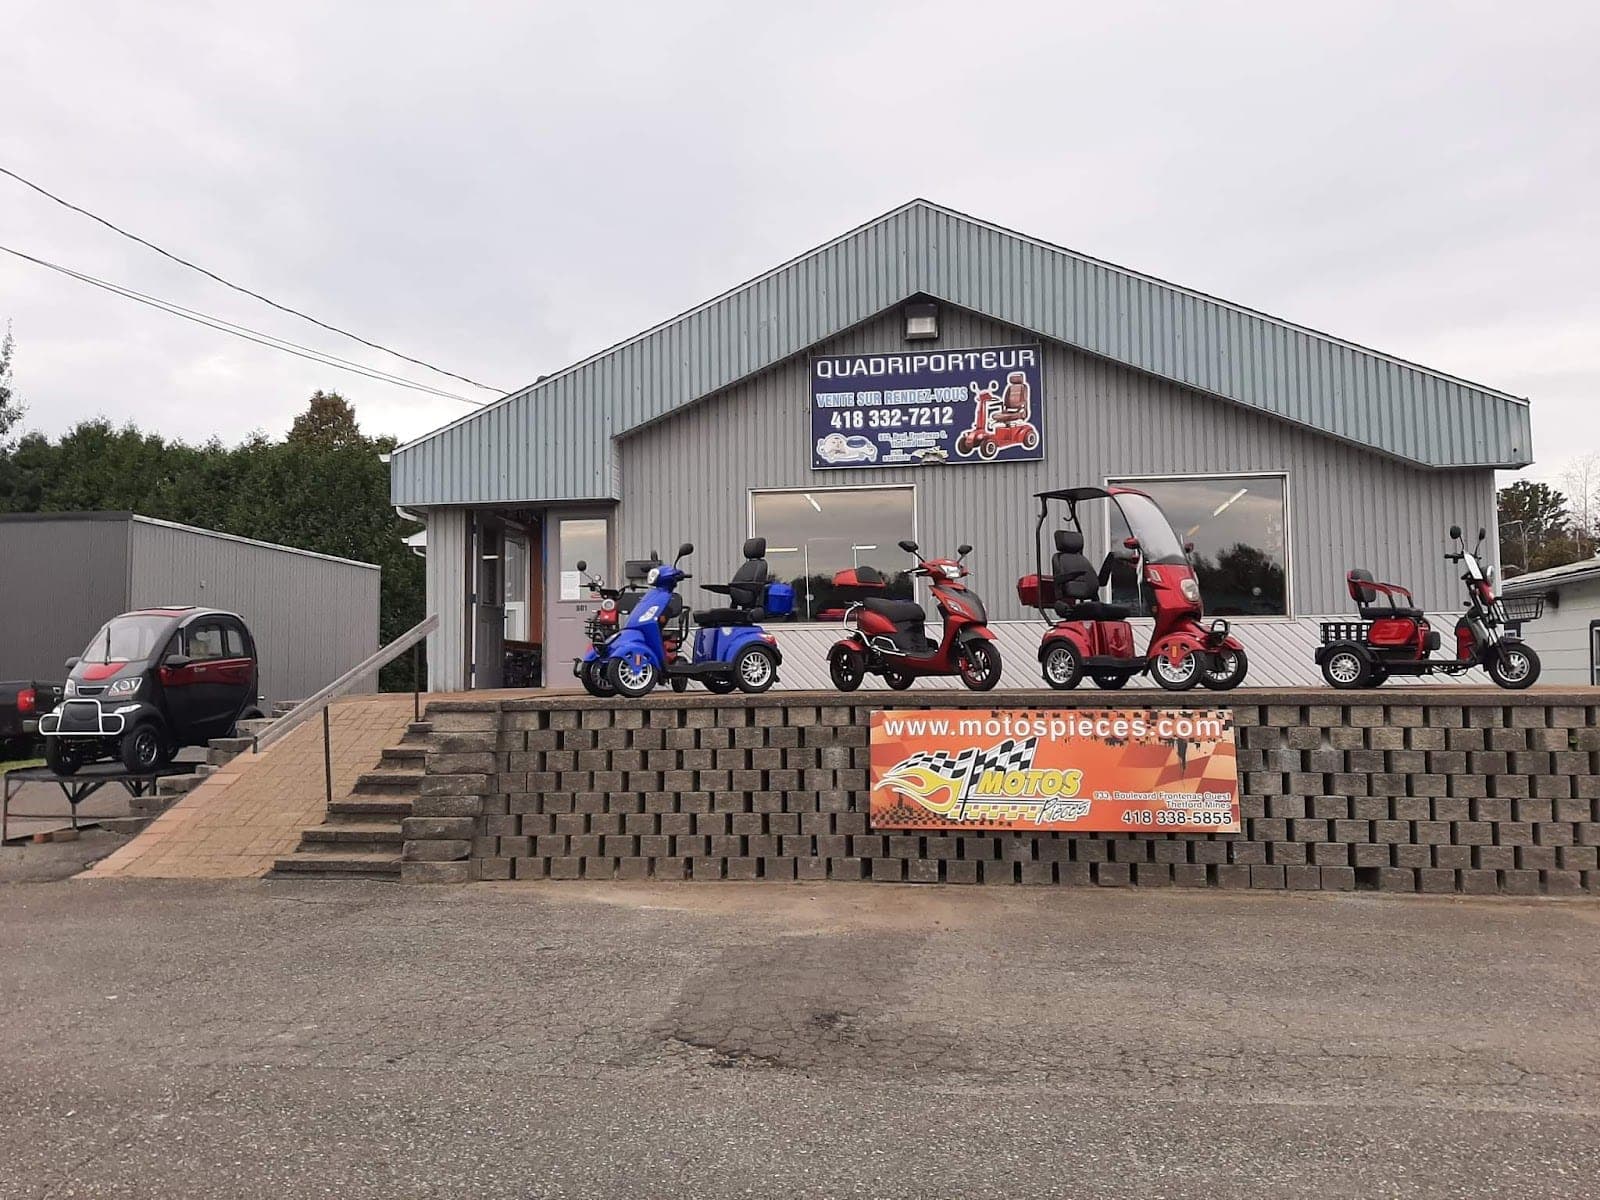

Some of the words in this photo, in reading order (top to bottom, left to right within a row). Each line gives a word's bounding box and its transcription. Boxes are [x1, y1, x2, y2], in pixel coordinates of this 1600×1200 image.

[816, 349, 1035, 379] QUADRIPORTEUR
[816, 392, 855, 408] VENTE
[856, 391, 882, 407] SUR
[884, 386, 968, 405] RENDEZ-VOUS
[830, 409, 864, 429] 418
[868, 406, 953, 428] 332-7212
[883, 714, 1223, 742] www.motospieces.com
[976, 769, 1083, 796] MOTOS
[1114, 791, 1156, 800] Boulevard
[1204, 801, 1231, 809] Mines
[1122, 811, 1152, 825] 418
[1157, 811, 1232, 825] 338-5855
